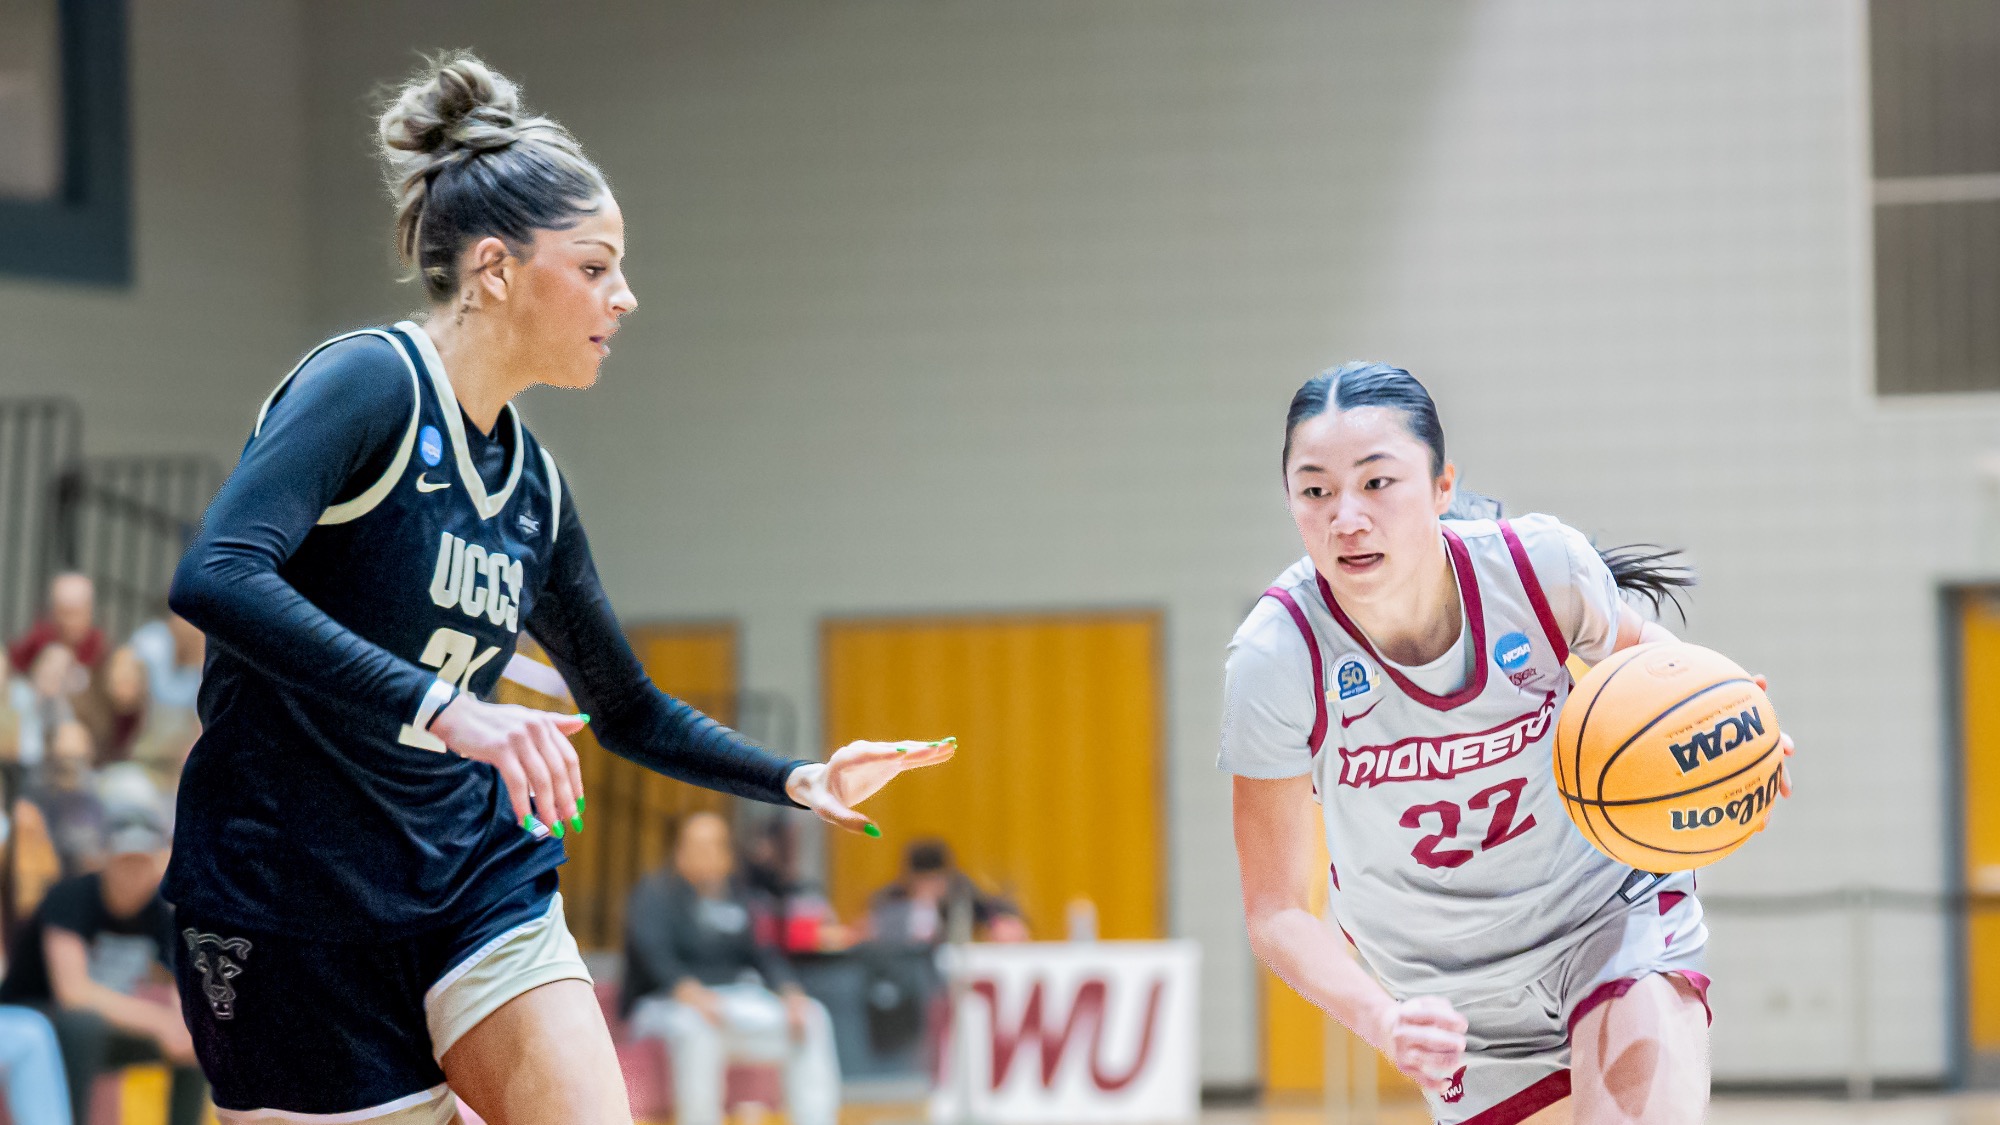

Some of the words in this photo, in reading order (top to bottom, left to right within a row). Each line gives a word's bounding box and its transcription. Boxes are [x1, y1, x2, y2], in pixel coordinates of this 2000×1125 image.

[430, 531, 524, 633] UCCS
[1502, 643, 1531, 664] NCAA
[1341, 667, 1363, 689] 50
[1668, 705, 1766, 773] NCAA
[1399, 777, 1538, 869] 22
[1442, 1083, 1463, 1101] TWU
